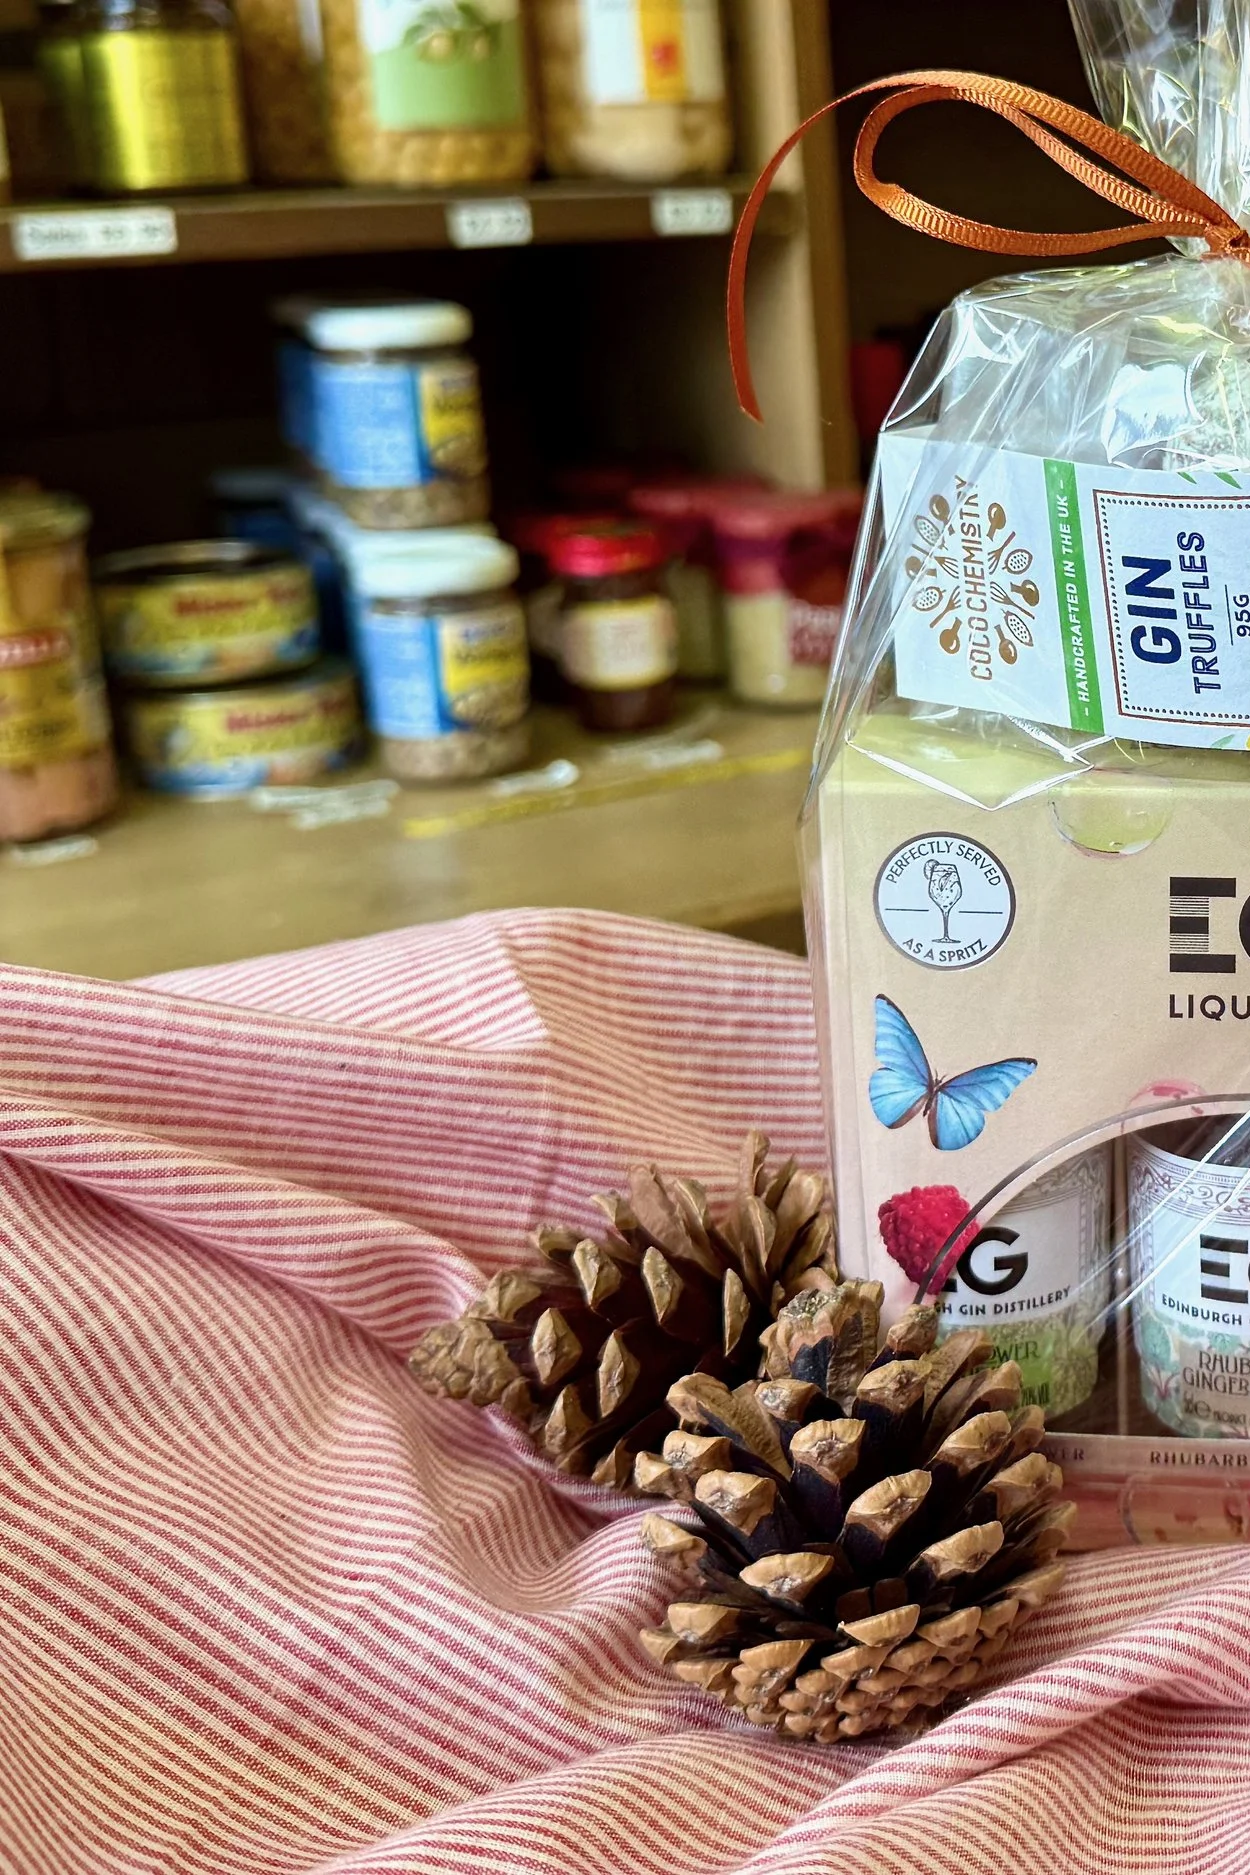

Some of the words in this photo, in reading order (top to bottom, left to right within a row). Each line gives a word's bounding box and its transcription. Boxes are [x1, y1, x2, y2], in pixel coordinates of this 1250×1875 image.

[1056, 495, 1069, 518] UK
[1060, 522, 1073, 556] THE
[1063, 560, 1077, 579] IN
[1121, 555, 1182, 665] GIN
[1177, 531, 1222, 695] TRUFFLES
[1066, 585, 1091, 703] HANDCRAFTED
[886, 840, 953, 884] PERFECTLY
[956, 844, 1001, 886] SERVED
[903, 938, 923, 954] AS
[924, 949, 935, 961] A
[939, 938, 988, 962] SPRITZ
[959, 1303, 986, 1316] GIN
[994, 1286, 1072, 1315] DISTILLERY
[1162, 1294, 1242, 1326] EDINBURGH
[1182, 1367, 1249, 1396] GINGER
[1149, 1449, 1248, 1468] RHUBARB
